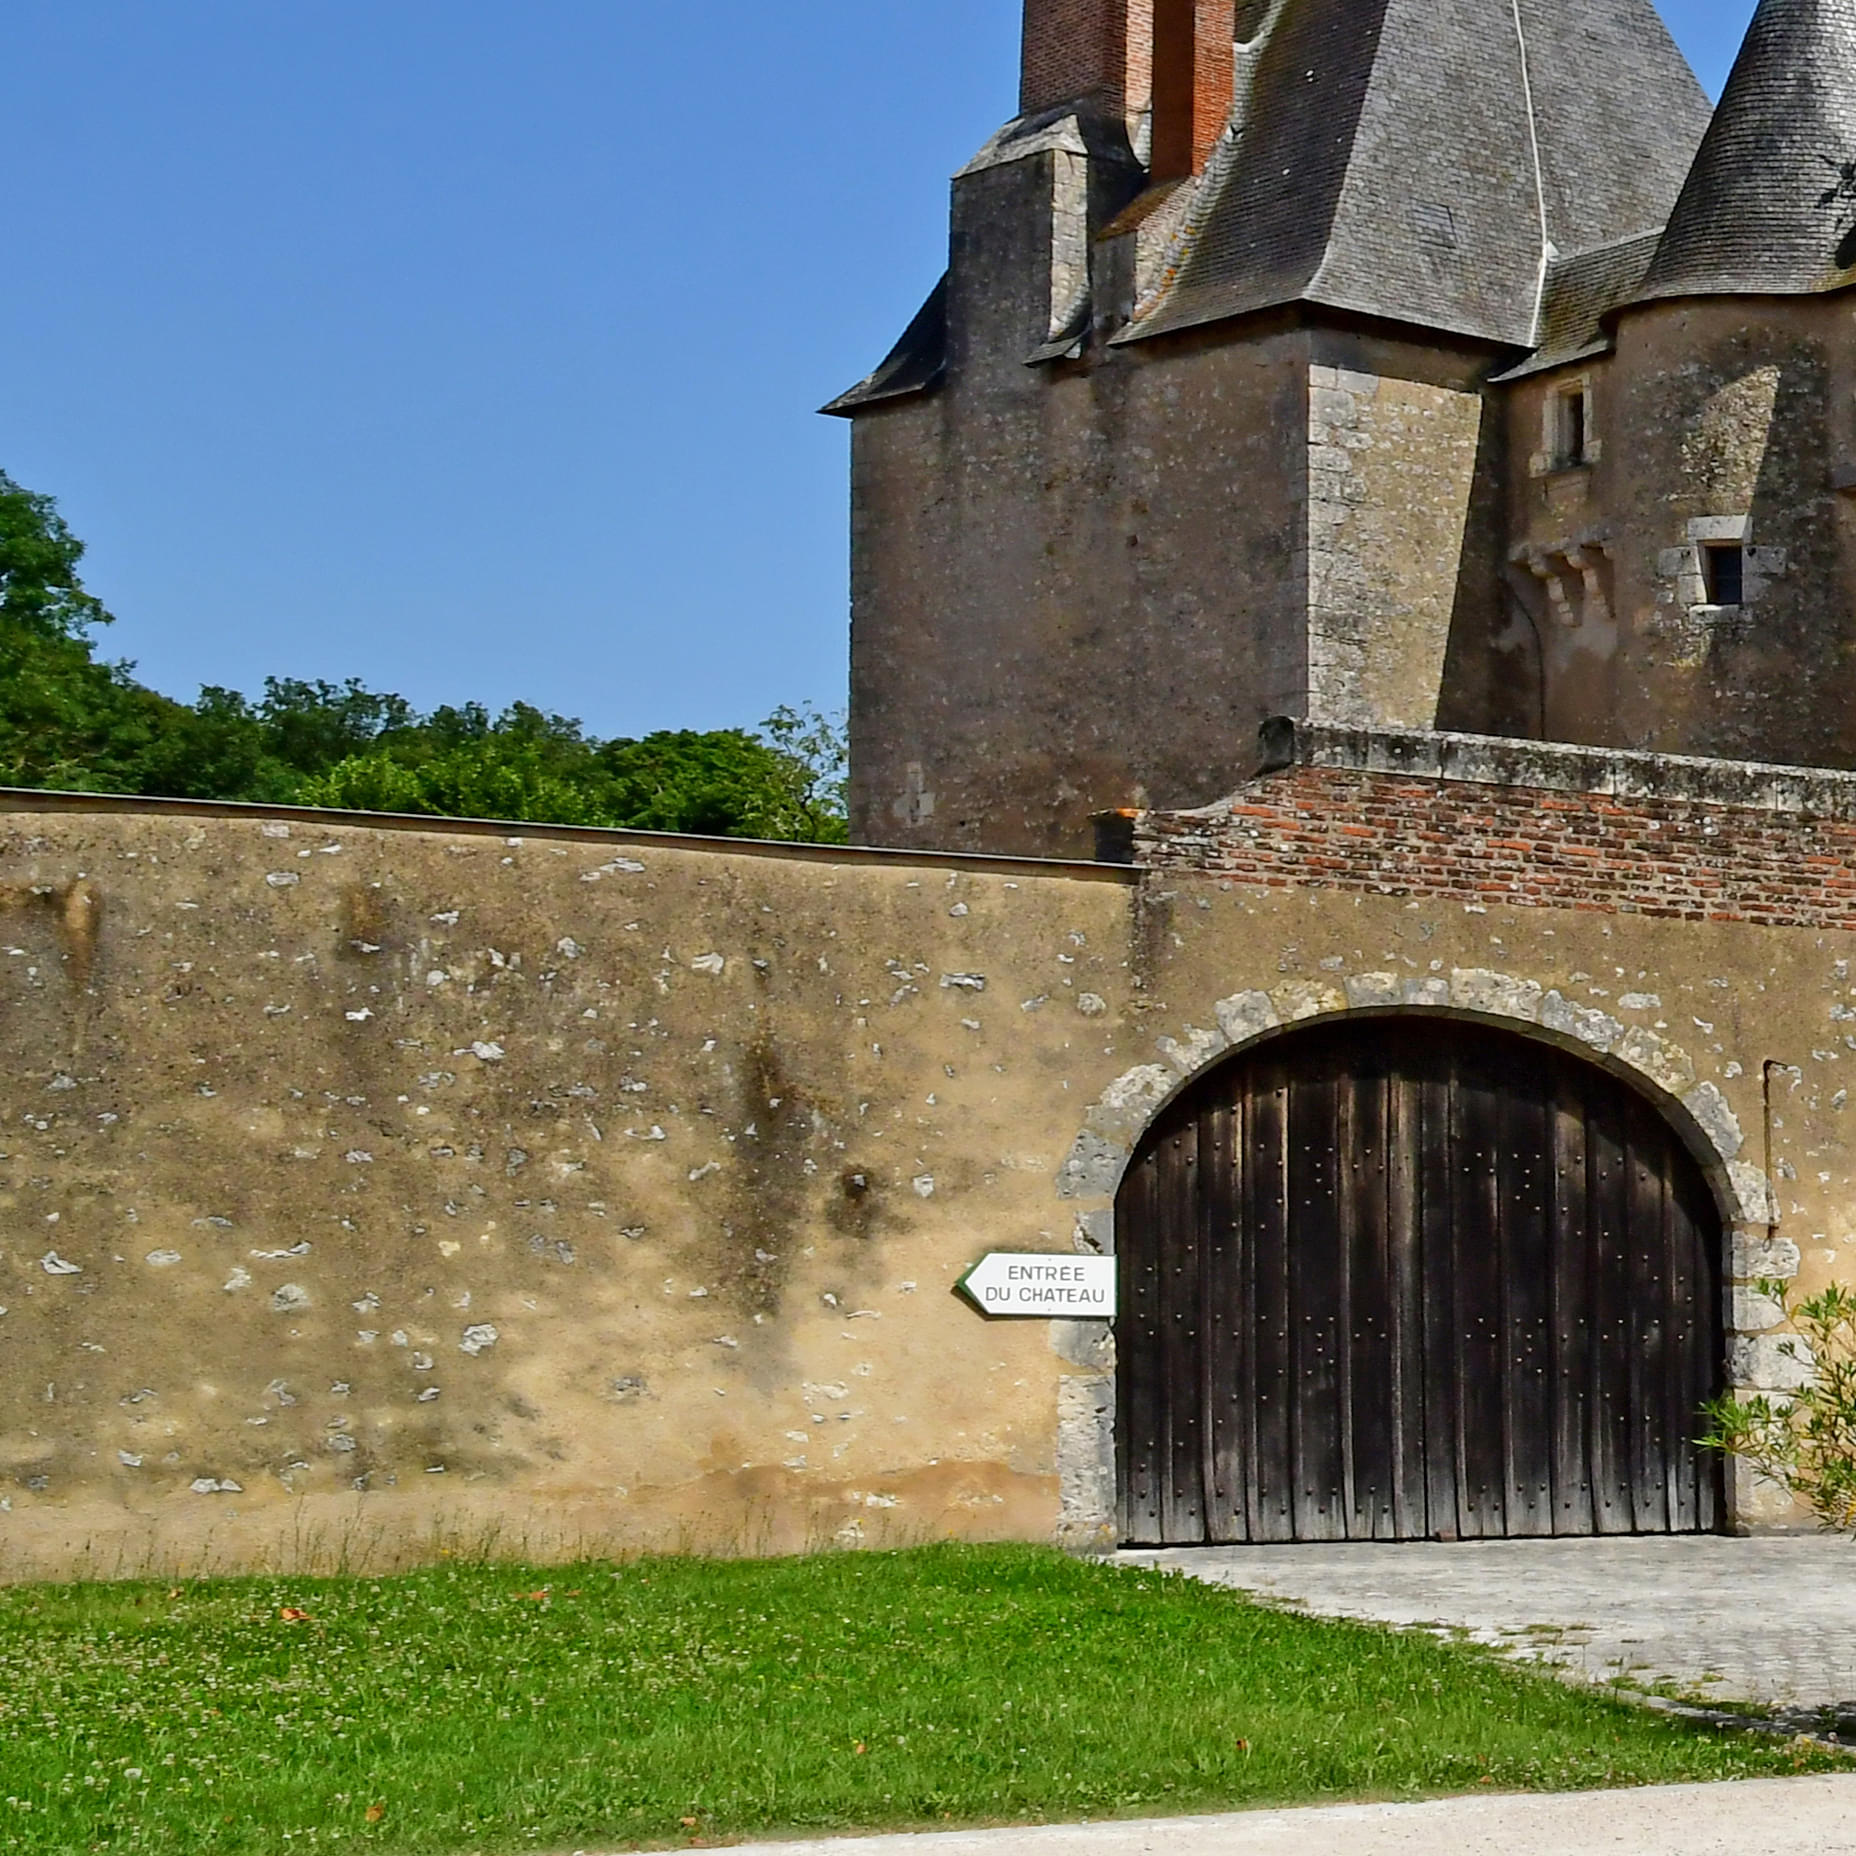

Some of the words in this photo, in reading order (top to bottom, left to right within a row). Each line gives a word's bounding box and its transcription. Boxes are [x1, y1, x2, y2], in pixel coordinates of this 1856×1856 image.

[1008, 1265, 1086, 1281] ENTRÉE
[985, 1287, 1011, 1301] DU
[1019, 1287, 1105, 1303] CHATEAU
